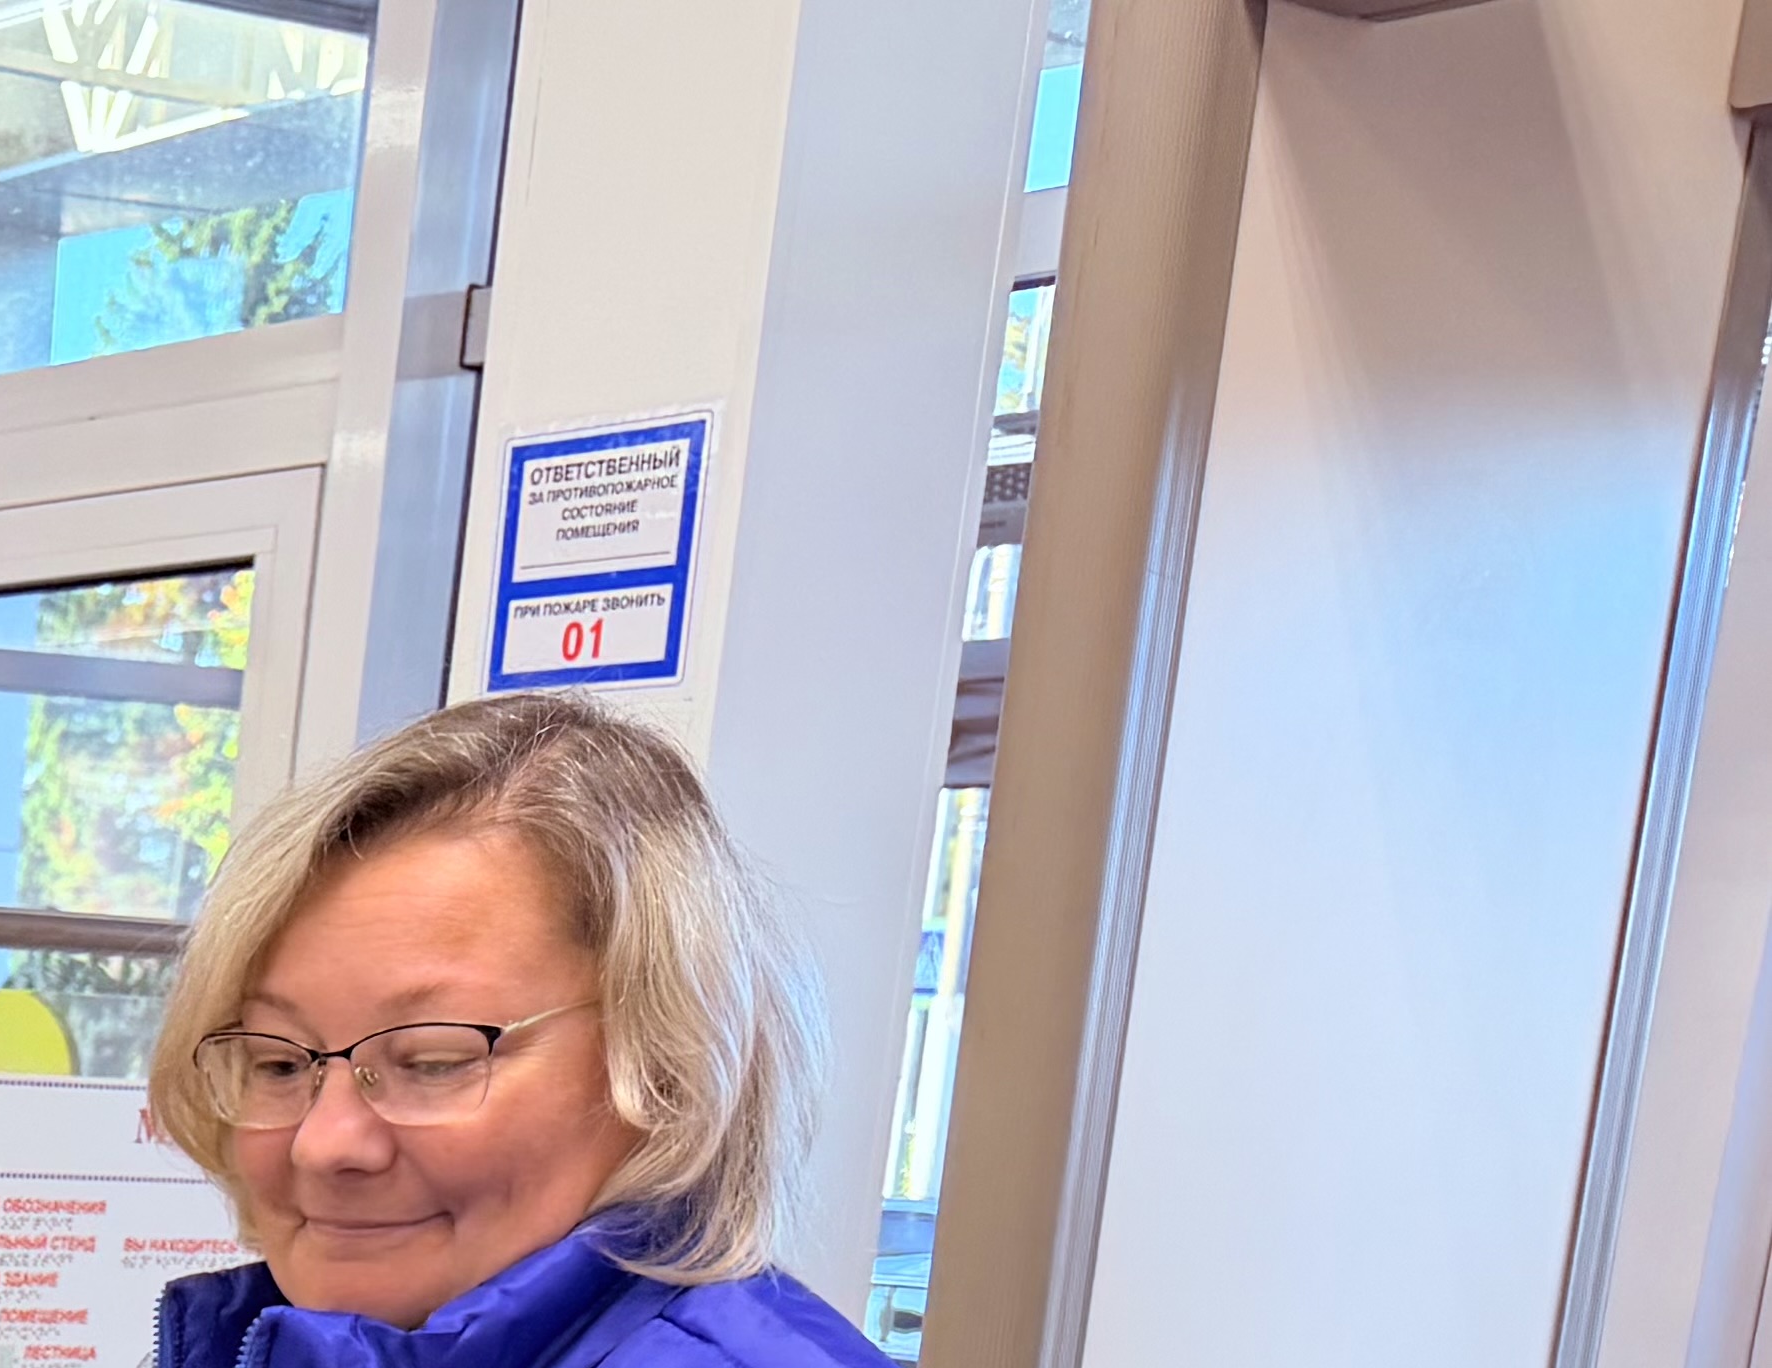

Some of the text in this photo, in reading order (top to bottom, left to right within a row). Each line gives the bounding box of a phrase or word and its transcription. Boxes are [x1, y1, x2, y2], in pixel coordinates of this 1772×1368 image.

[530, 445, 681, 486] ОТВЕТСТВЕННЫЙ
[528, 474, 678, 505] ЗА ПРОТИВОПОЖАРНОЕ
[561, 499, 638, 521] СОСТОЯНИЕ
[556, 520, 640, 541] ПОМЕЩЕНИЯ
[513, 592, 666, 619] ПРИ ПОЖАРЕ ЗВОНИТЬ
[562, 617, 604, 661] 01
[3, 1199, 108, 1214] ОБОЗНАЧЕНИЯ
[50, 1235, 96, 1253] СТЕНД
[2, 1271, 59, 1288] ЗДАНИЕ
[23, 1345, 96, 1361] ЛЕСТНИЦА
